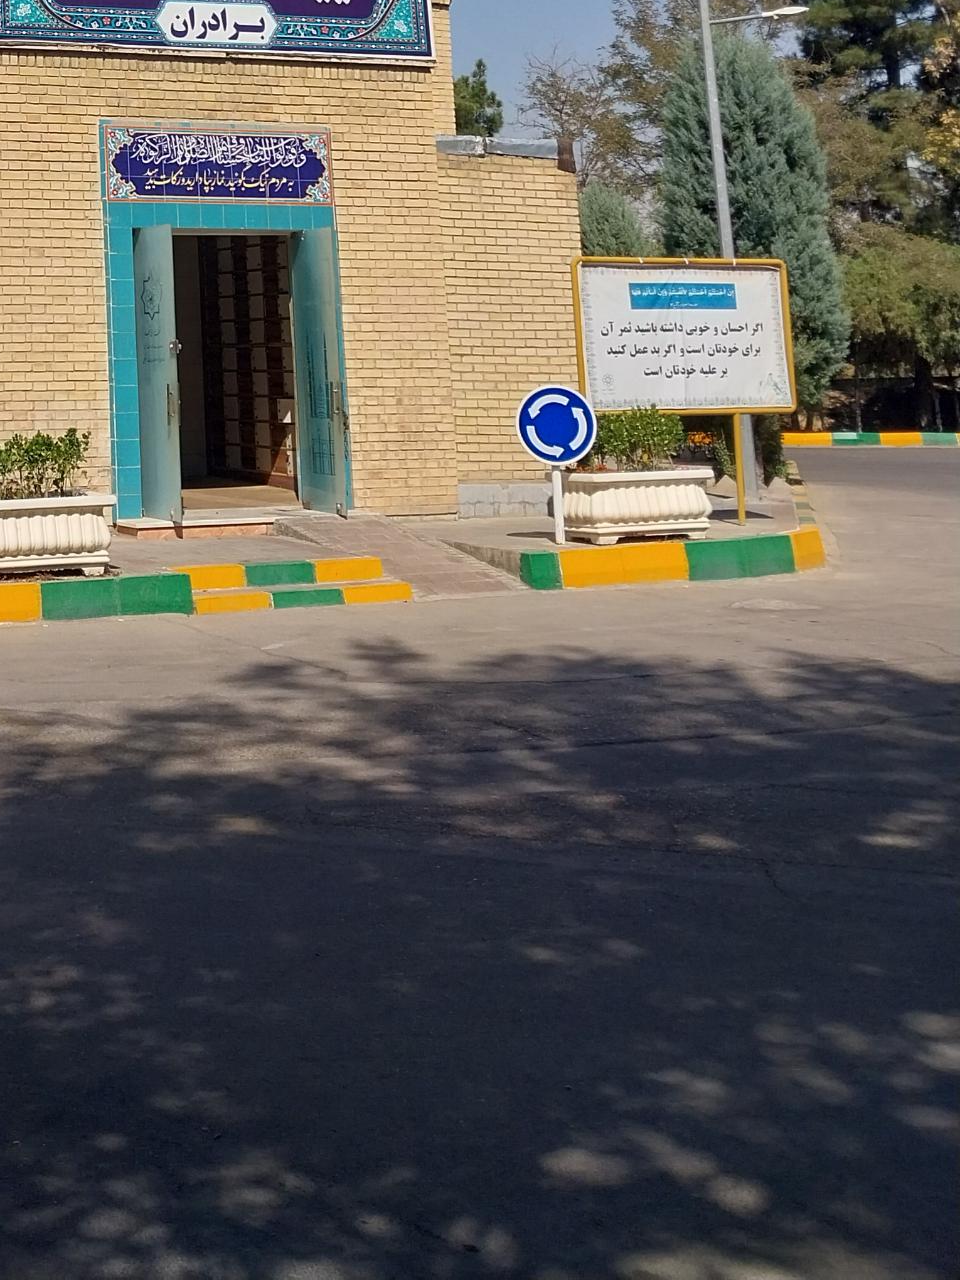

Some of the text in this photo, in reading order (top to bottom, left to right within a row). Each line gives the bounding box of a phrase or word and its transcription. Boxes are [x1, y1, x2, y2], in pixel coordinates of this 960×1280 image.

[170, 6, 266, 40] برادران
[600, 321, 614, 336] آن
[634, 322, 657, 336] باشید
[660, 321, 683, 332] داشته
[685, 322, 710, 336] خوبی
[713, 326, 718, 336] و
[721, 322, 748, 335] احسان
[751, 322, 763, 336] اگر
[607, 343, 761, 357] برای خودتان است و اگر بد عمل کنید
[643, 364, 728, 378] بر علیه خودتان است
